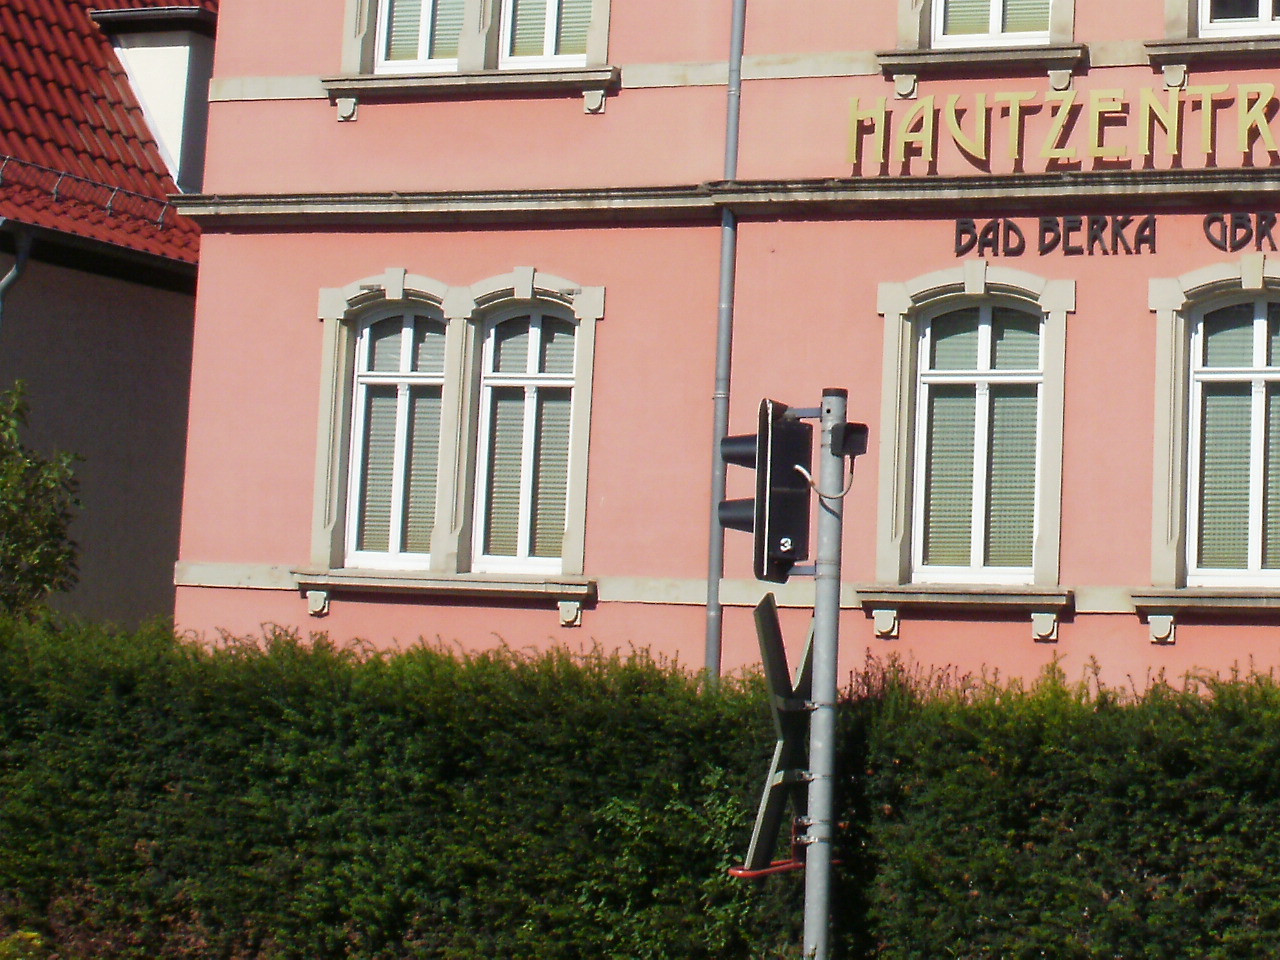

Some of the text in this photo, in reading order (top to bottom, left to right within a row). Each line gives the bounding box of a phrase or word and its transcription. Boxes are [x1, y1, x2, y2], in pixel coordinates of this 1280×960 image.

[954, 212, 1278, 258] BAD BERKA GBR
